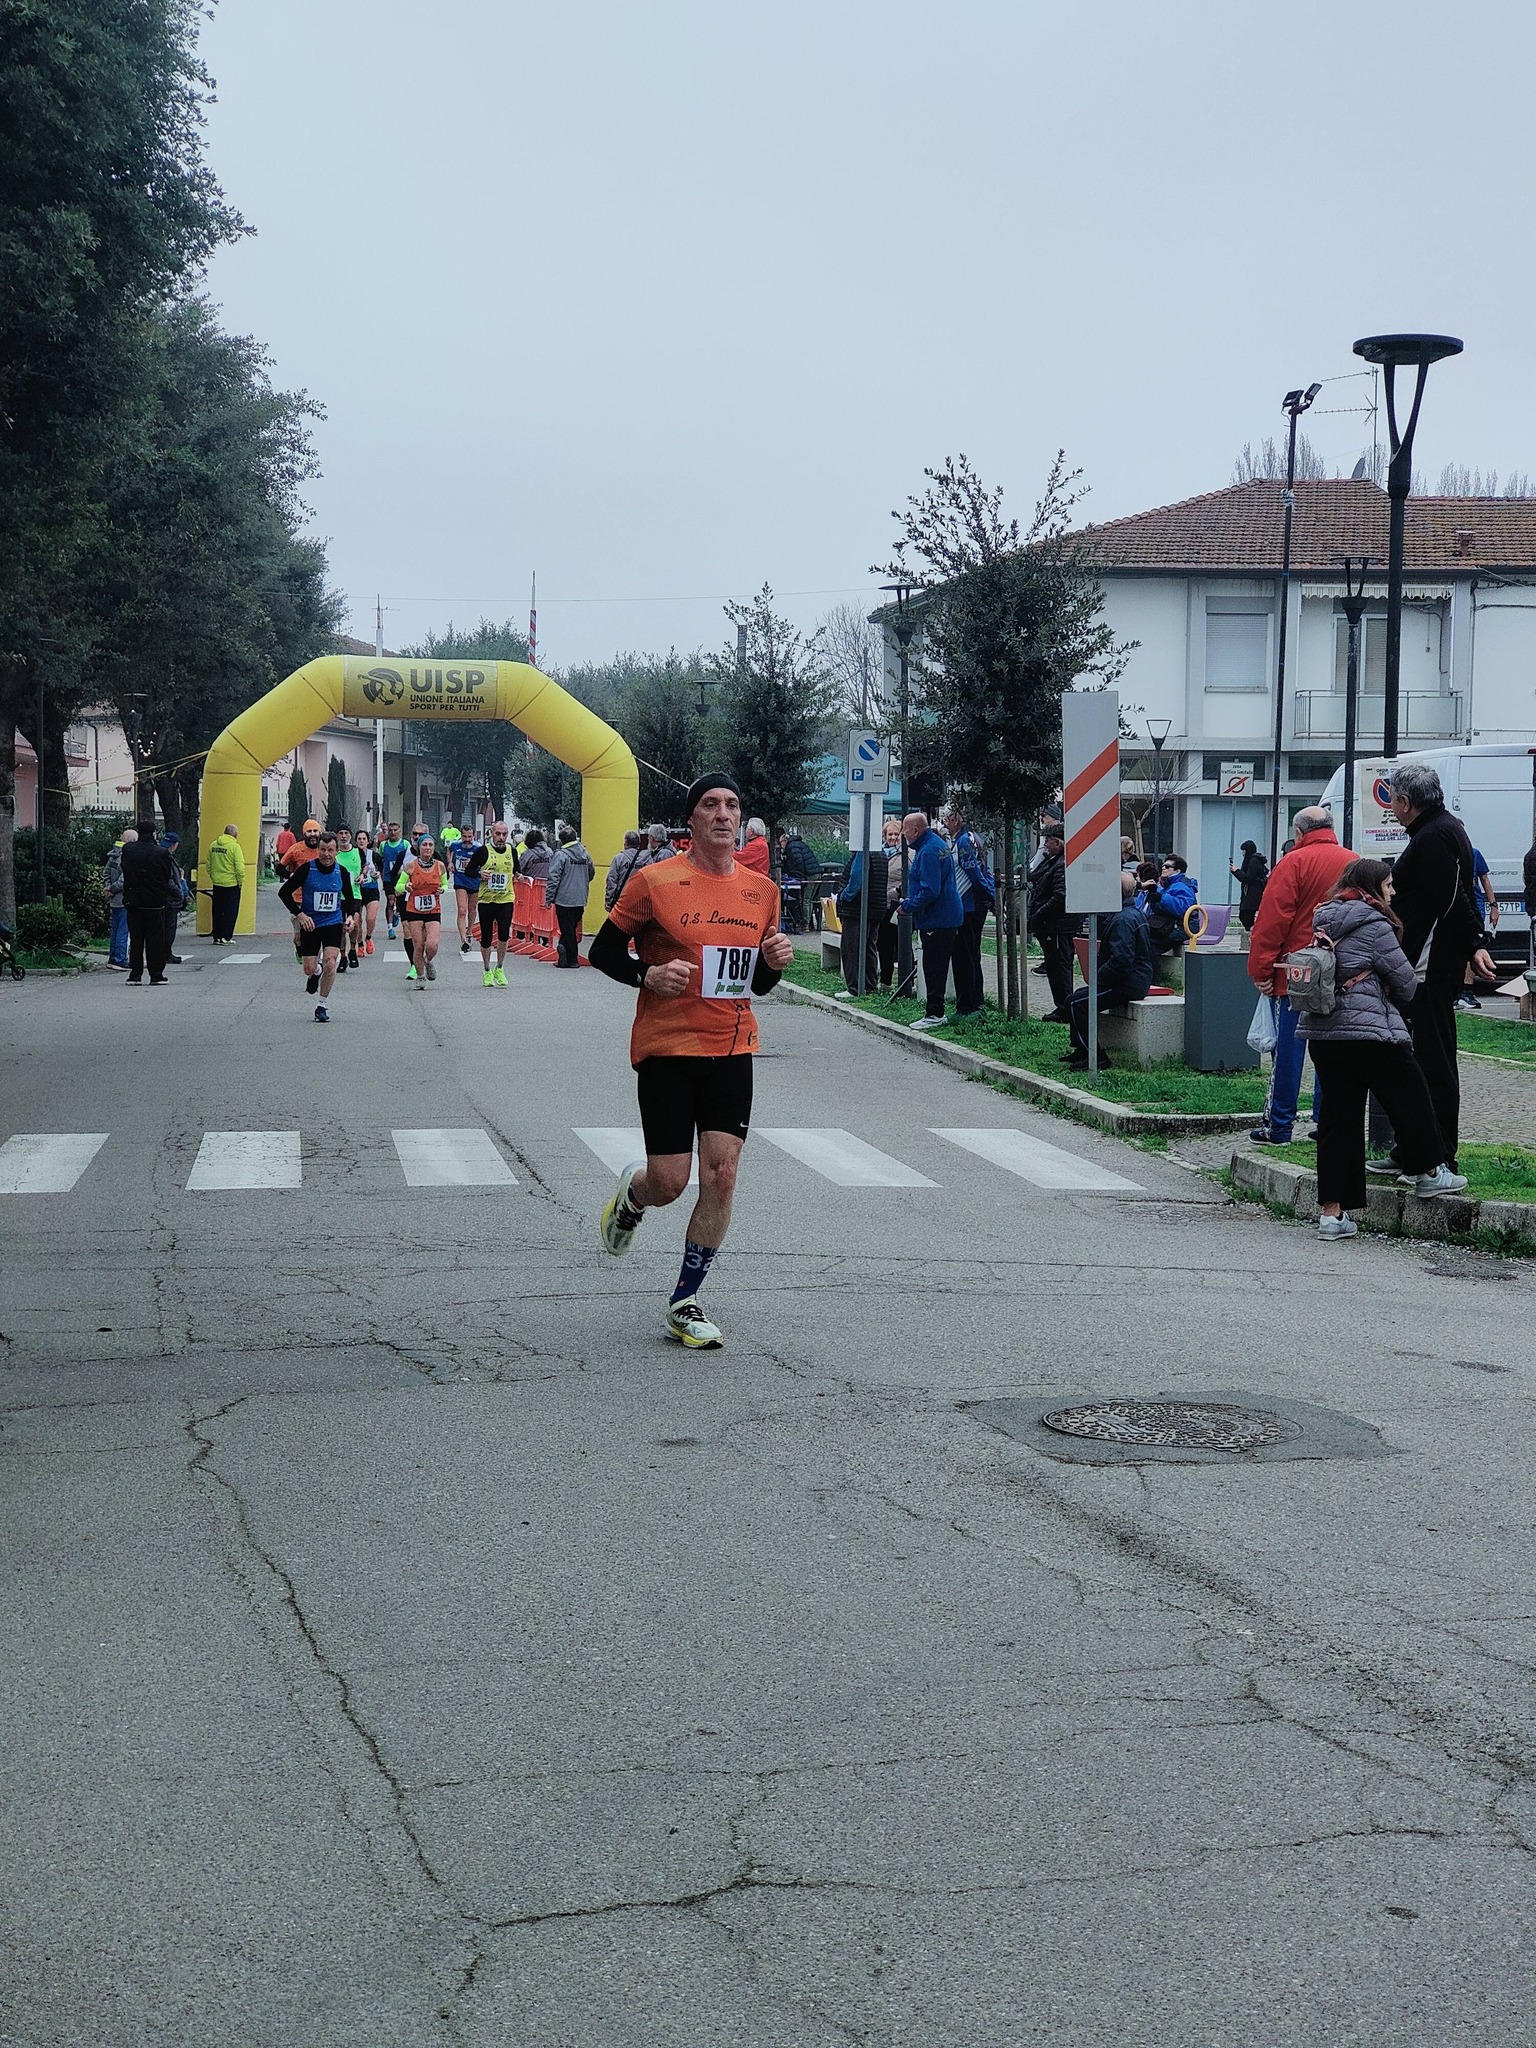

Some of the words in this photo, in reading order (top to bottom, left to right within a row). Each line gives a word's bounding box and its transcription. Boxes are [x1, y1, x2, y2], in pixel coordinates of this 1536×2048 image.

[410, 669, 485, 693] UISP
[410, 694, 444, 703] UNIONE
[446, 695, 485, 704] ITALIANA
[409, 703, 437, 711] SPORT
[853, 769, 862, 780] P
[491, 873, 505, 884] 686
[319, 892, 334, 905] 704
[419, 895, 432, 907] 789
[680, 912, 703, 927] G.S.
[707, 910, 759, 931] Lamone
[717, 947, 751, 981] 788
